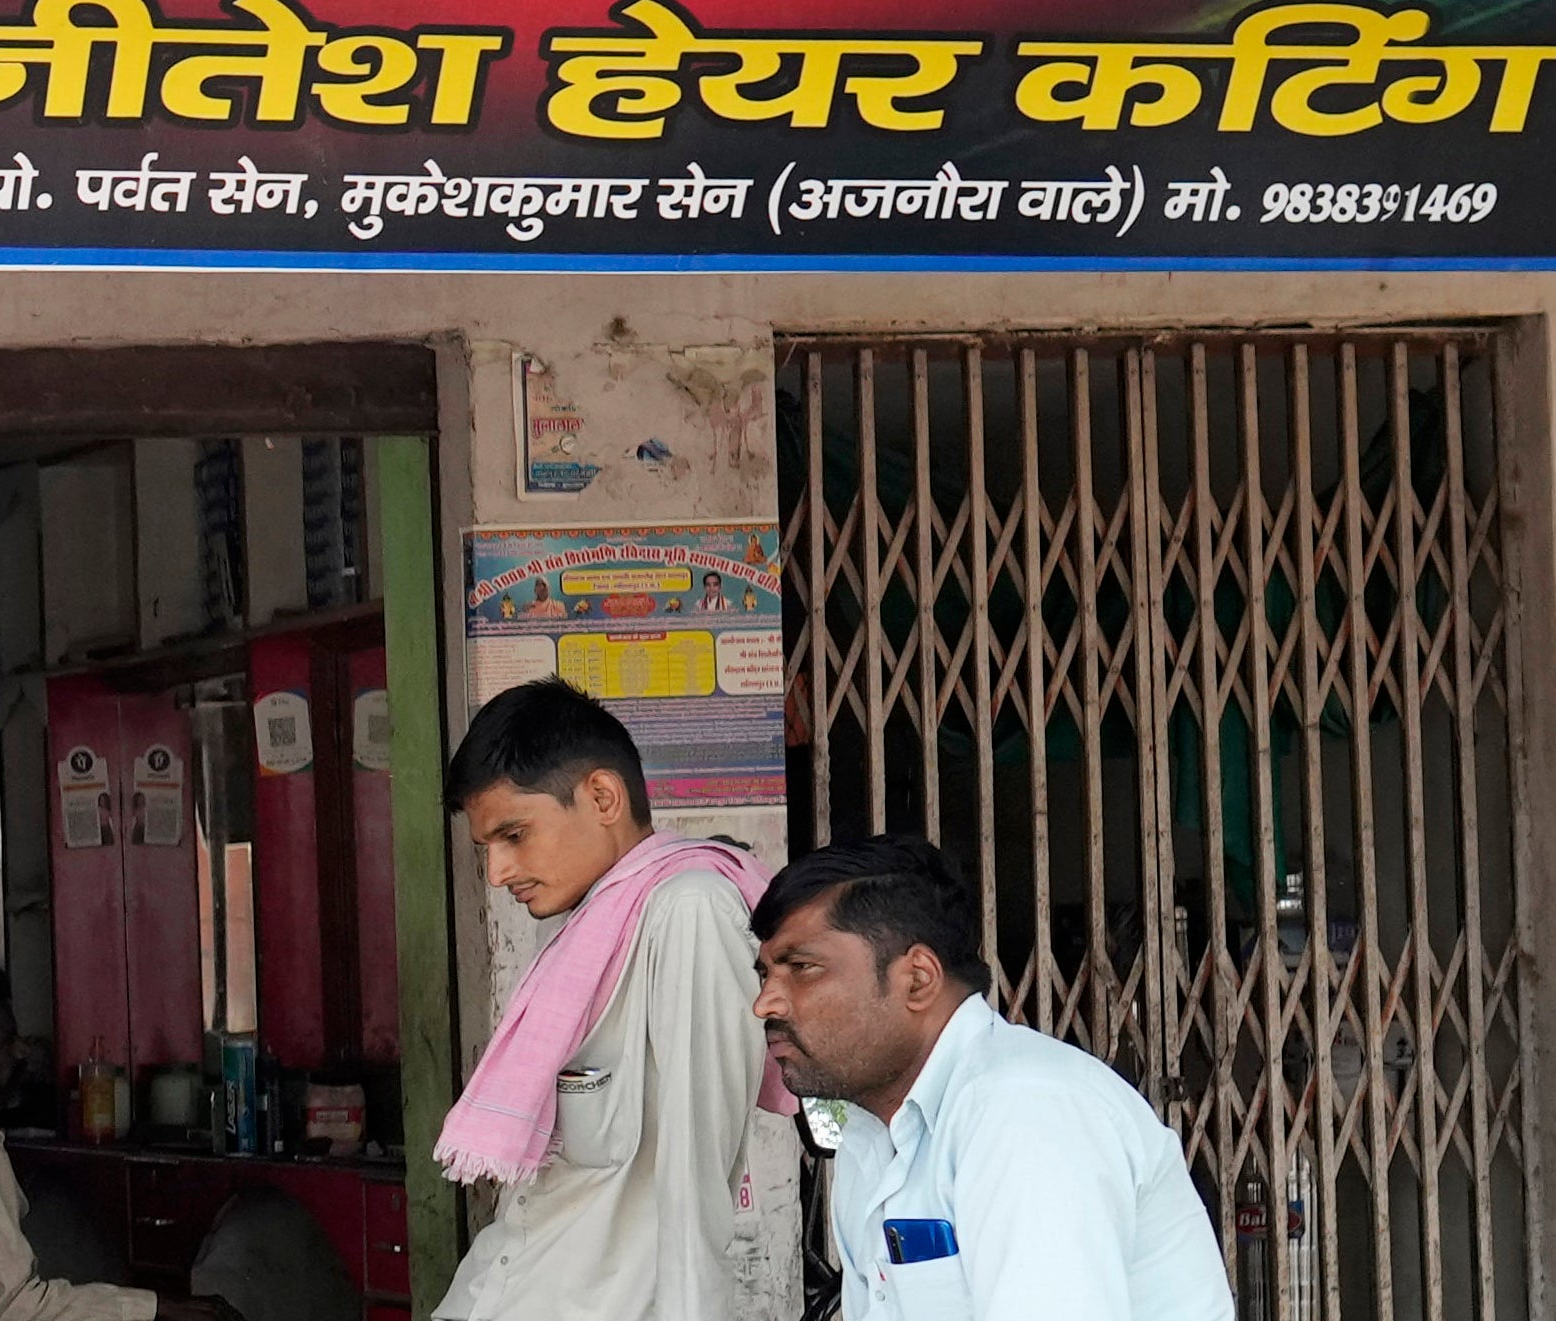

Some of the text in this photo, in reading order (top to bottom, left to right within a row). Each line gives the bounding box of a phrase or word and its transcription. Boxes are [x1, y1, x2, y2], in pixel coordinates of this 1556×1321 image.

[548, 0, 982, 138] हेयर
[1016, 3, 1556, 137] कटिंग
[76, 152, 196, 215] पर्वत
[207, 157, 318, 222] सेन,
[341, 160, 649, 243] मुकेशकुमार
[655, 163, 752, 220] सेन
[769, 160, 1008, 234] (अजनौरा
[1016, 165, 1146, 237] वाले)
[1165, 166, 1236, 222] मो.
[1260, 183, 1497, 223] 9838391469
